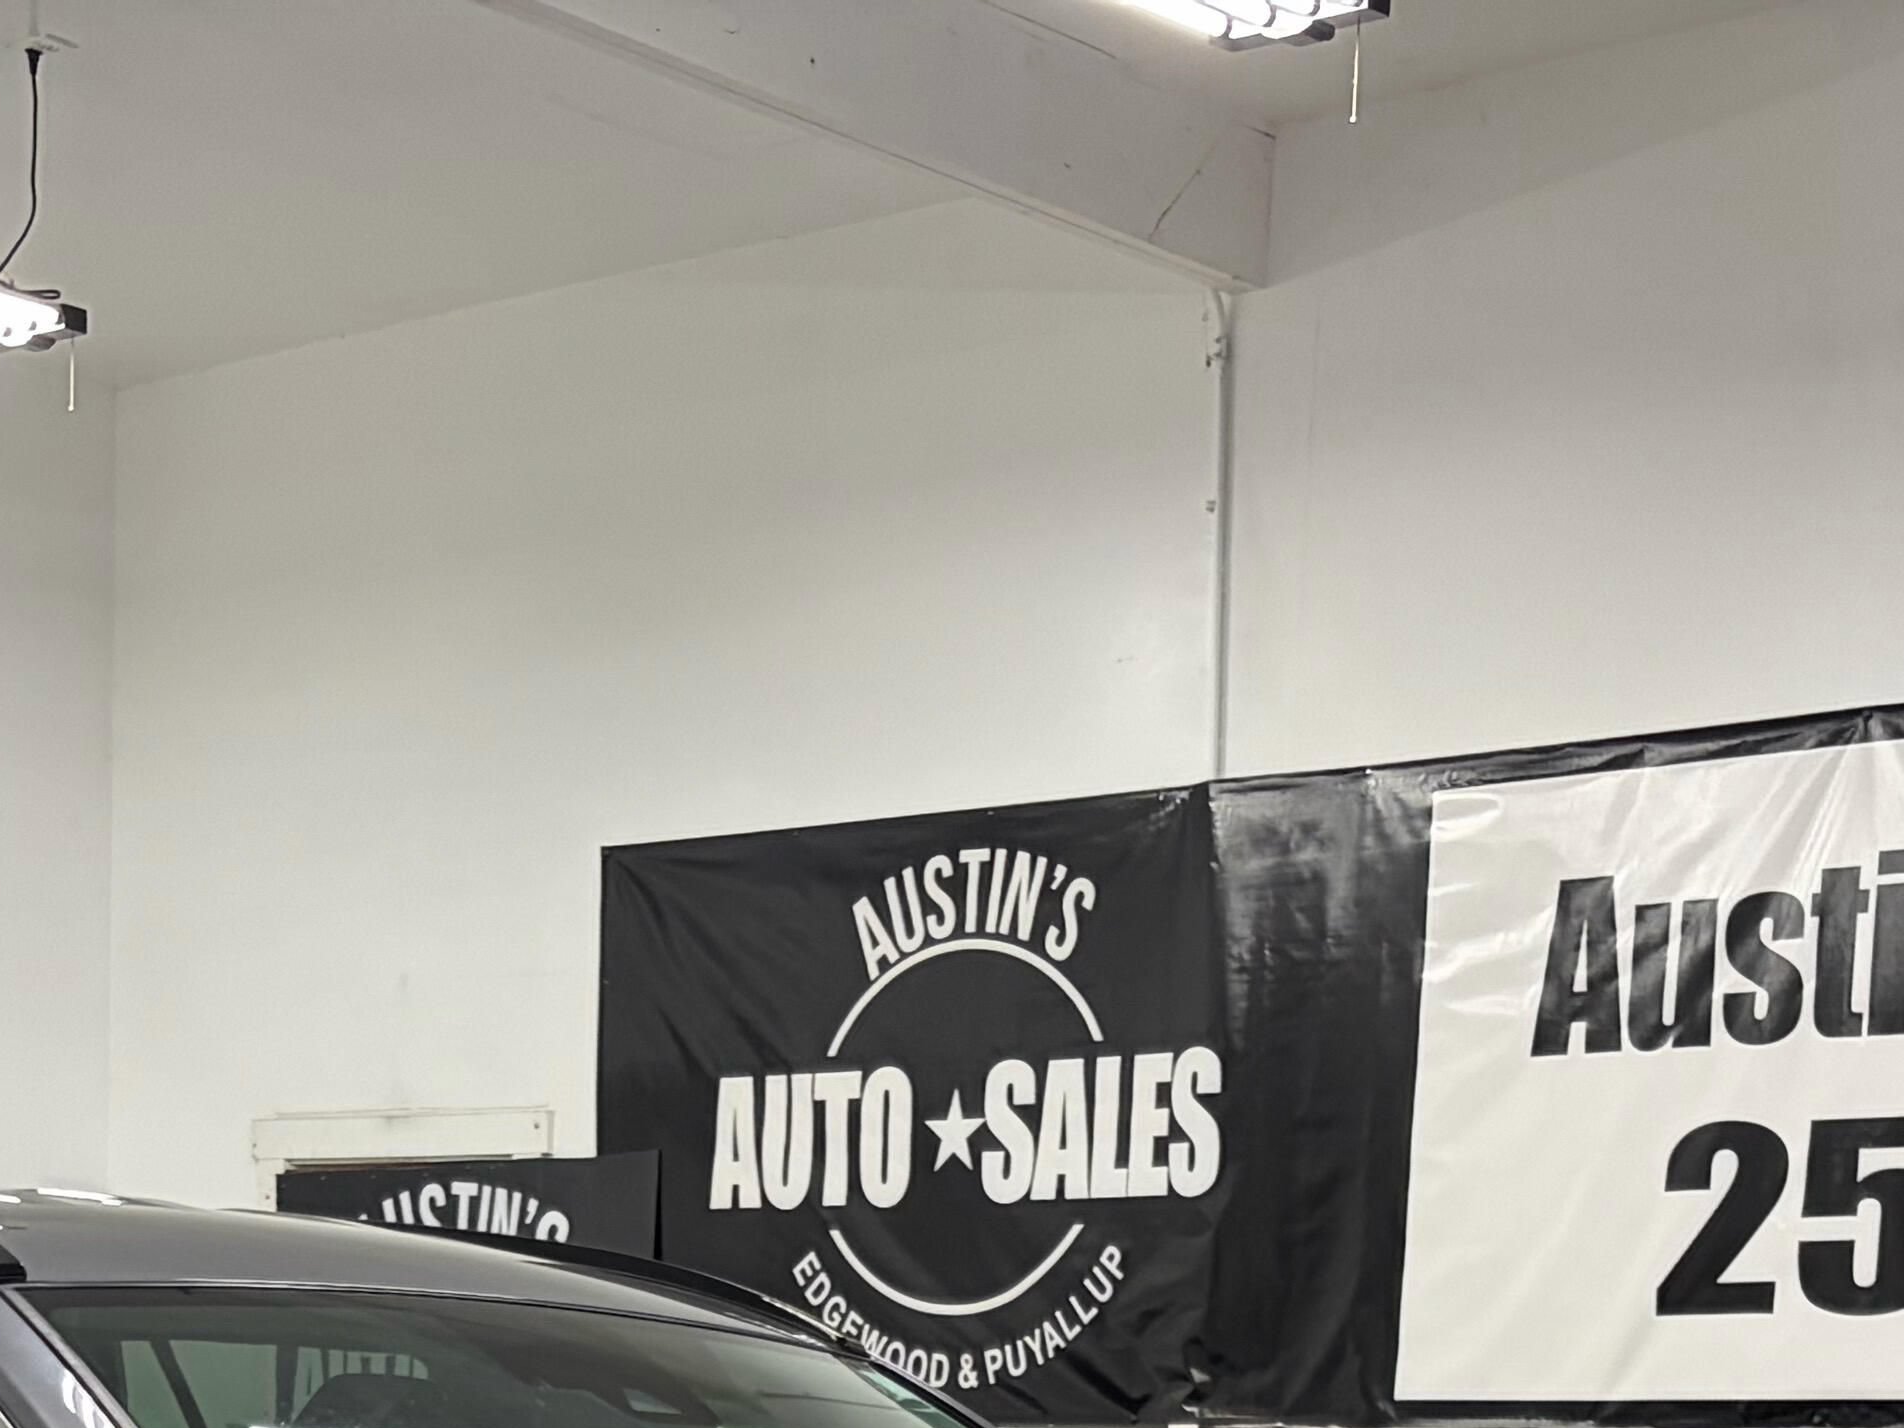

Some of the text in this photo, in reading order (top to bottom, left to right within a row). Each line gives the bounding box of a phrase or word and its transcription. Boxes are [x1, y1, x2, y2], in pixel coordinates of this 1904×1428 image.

[851, 847, 1097, 981] AUSTIN'S
[709, 1046, 1223, 1211] AUTO SALES
[957, 1353, 980, 1390] &
[983, 1244, 1125, 1385] PUYALLUP
